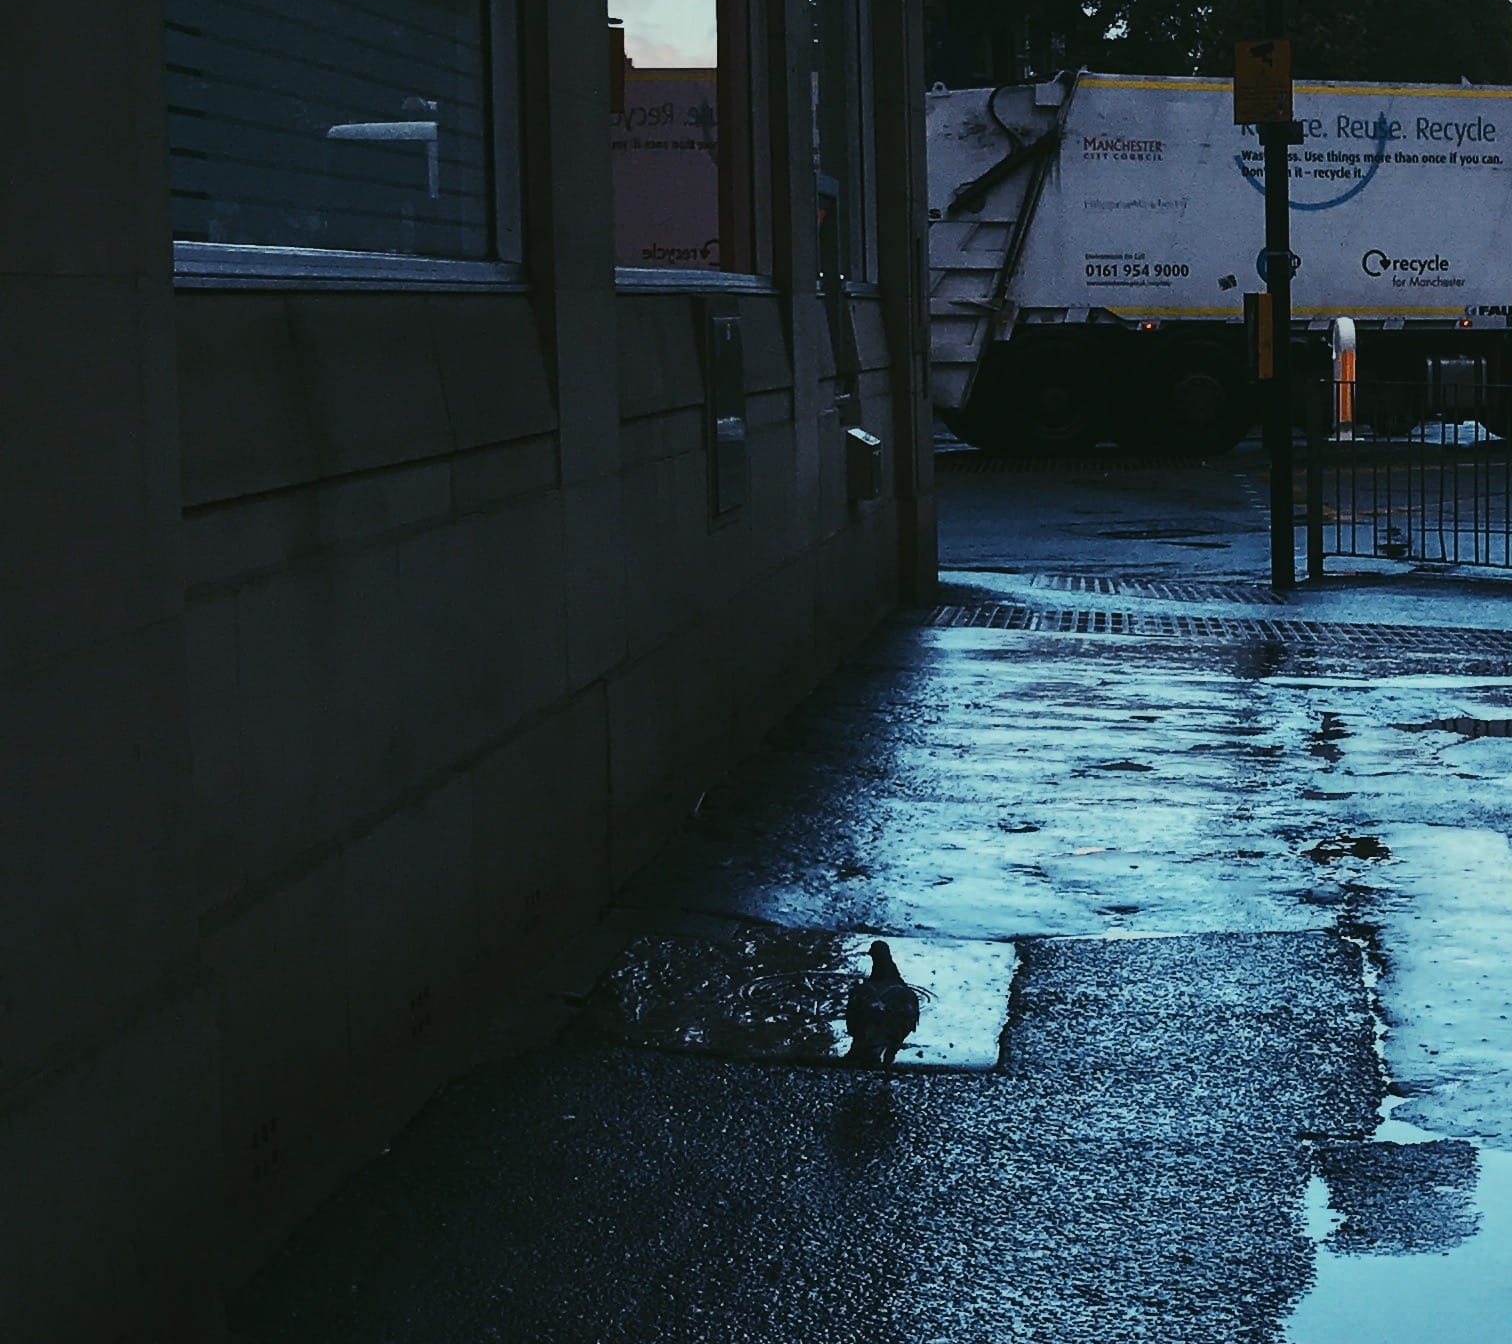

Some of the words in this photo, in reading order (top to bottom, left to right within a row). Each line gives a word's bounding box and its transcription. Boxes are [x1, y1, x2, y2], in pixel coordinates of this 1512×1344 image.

[1337, 115, 1408, 141] Reuse.
[1416, 116, 1496, 147] Recycle
[1083, 152, 1108, 160] CITY
[1113, 153, 1163, 161] COUNCIL
[1241, 150, 1264, 162] Was
[1304, 151, 1324, 162] Use
[1326, 150, 1360, 165] things
[1363, 152, 1391, 163] more
[1394, 151, 1419, 163] than
[1422, 153, 1446, 164] once
[1449, 151, 1457, 164] if
[1459, 153, 1479, 167] you
[1482, 153, 1504, 165] can.
[1241, 166, 1266, 177] Don'
[1294, 167, 1303, 178] it
[1313, 167, 1351, 180] recycle
[1085, 263, 1118, 277] 0161
[1123, 263, 1150, 277] 954
[1154, 263, 1190, 277] 9000
[1393, 254, 1449, 275] recycle
[1392, 276, 1406, 287] for
[1409, 276, 1466, 288] Manchester
